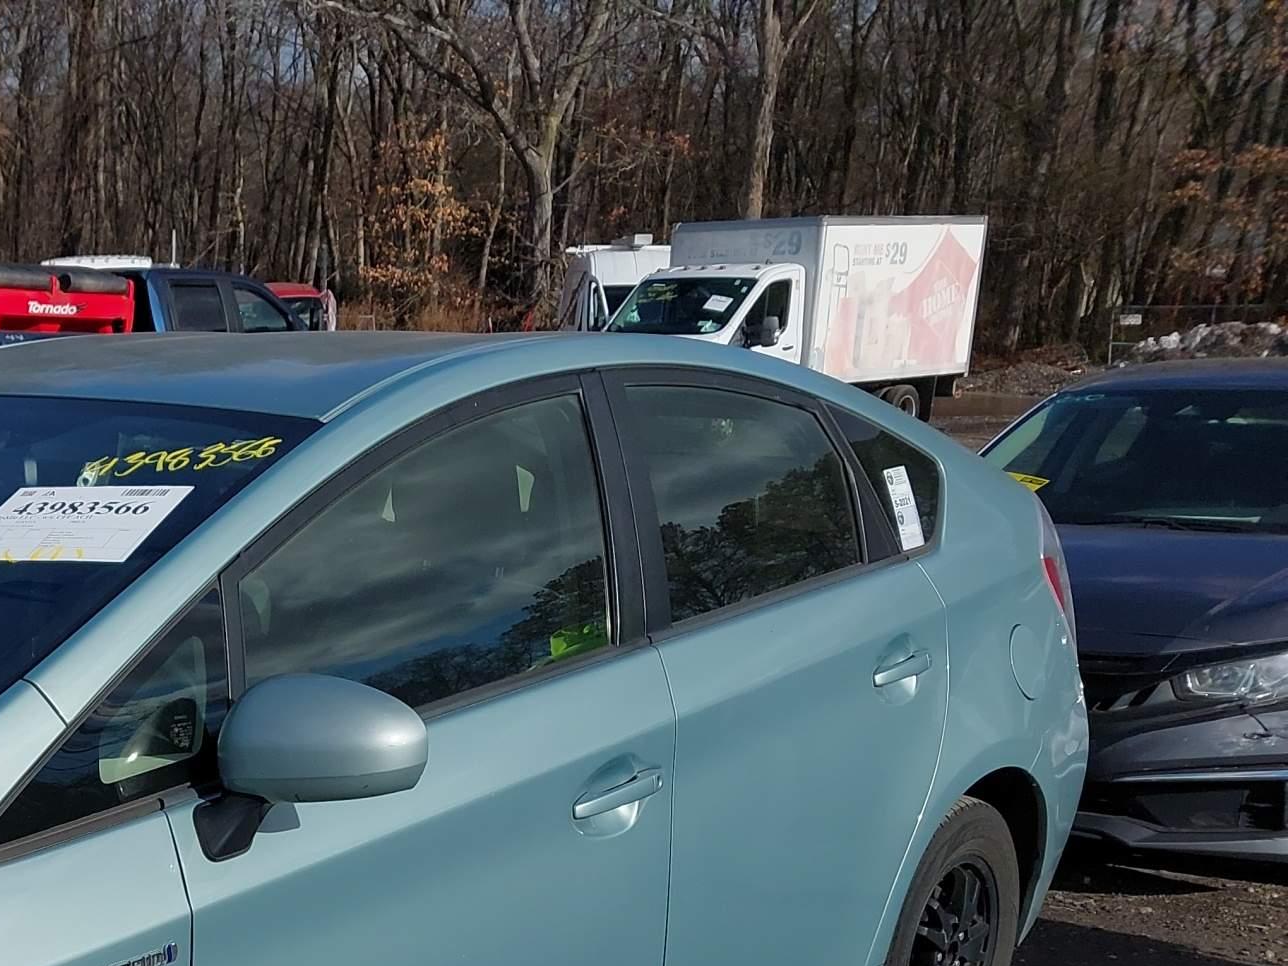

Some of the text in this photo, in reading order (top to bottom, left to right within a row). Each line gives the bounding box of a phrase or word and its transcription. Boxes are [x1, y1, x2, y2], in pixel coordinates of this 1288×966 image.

[885, 241, 908, 265] $29
[27, 300, 77, 315] Tornado
[12, 501, 157, 515] 43983566
